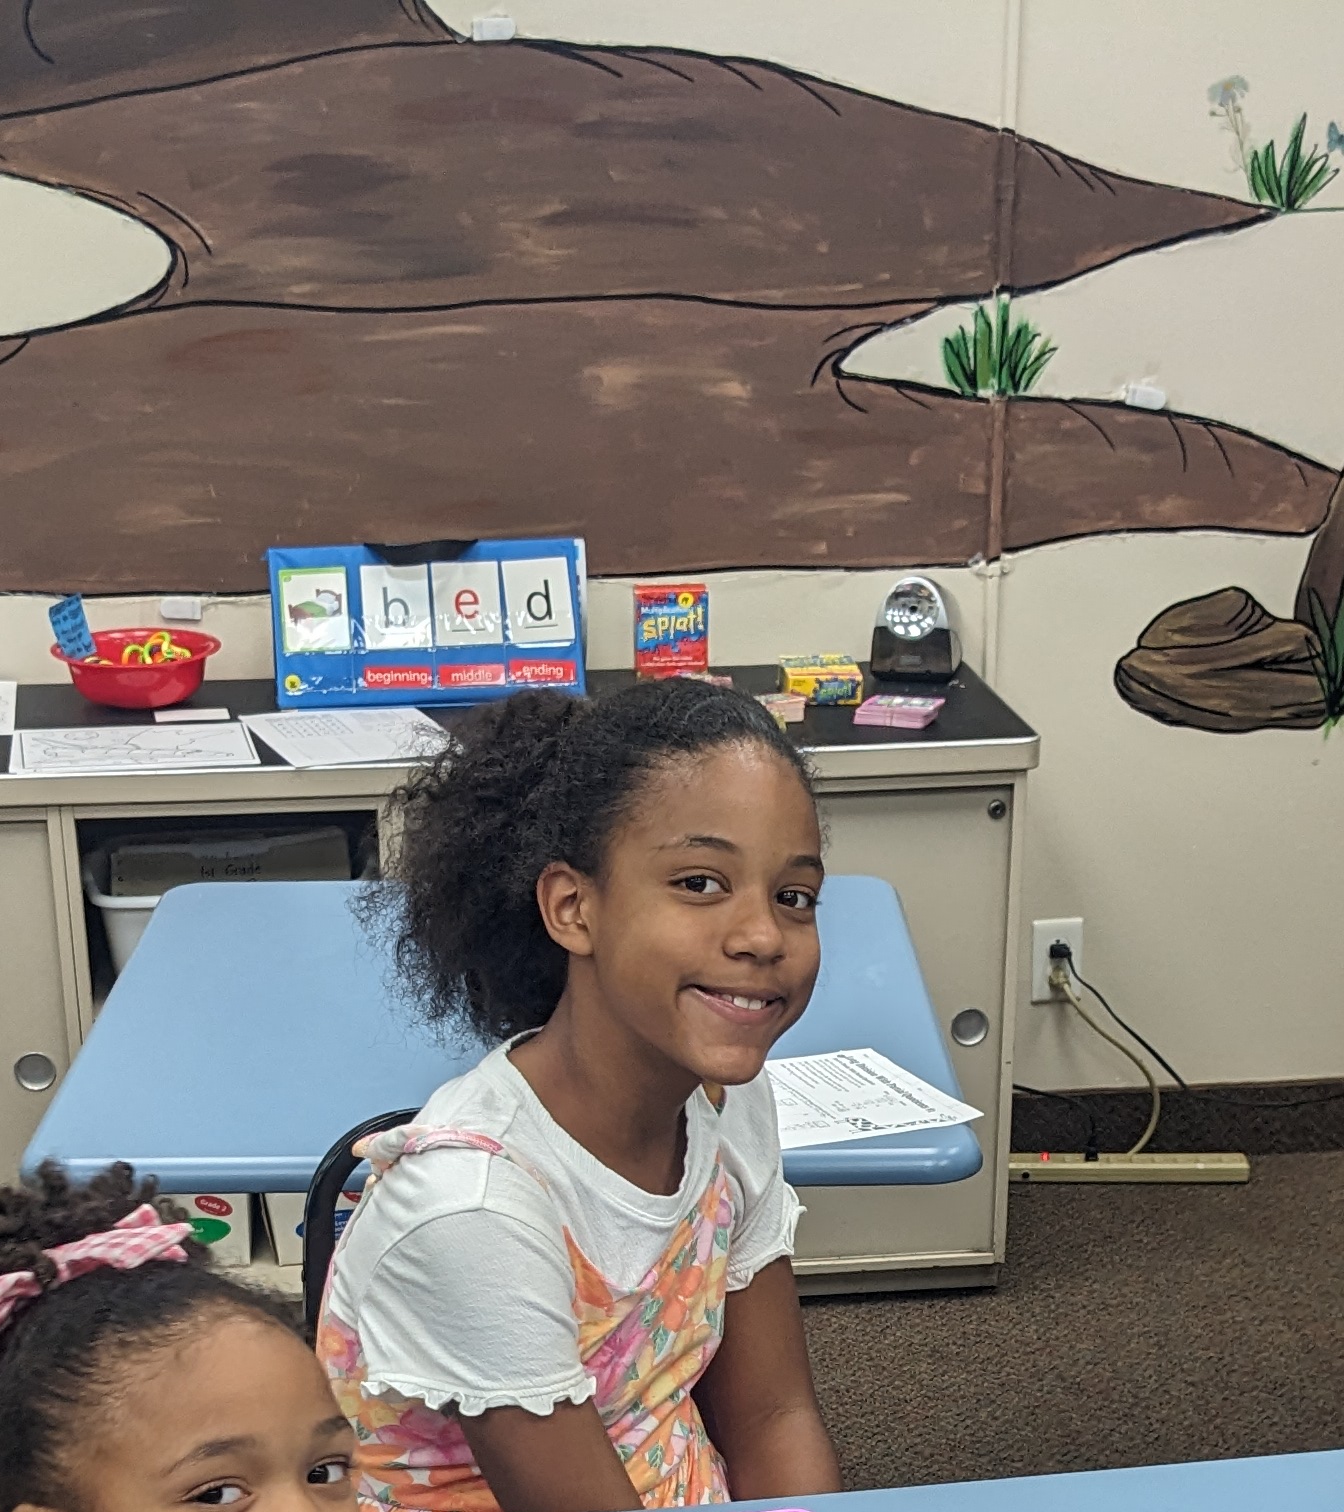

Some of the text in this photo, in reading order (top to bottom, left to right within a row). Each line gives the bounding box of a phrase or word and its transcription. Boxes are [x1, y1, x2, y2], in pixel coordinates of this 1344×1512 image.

[382, 578, 553, 628] b e d
[366, 661, 564, 685] beginning middle ending
